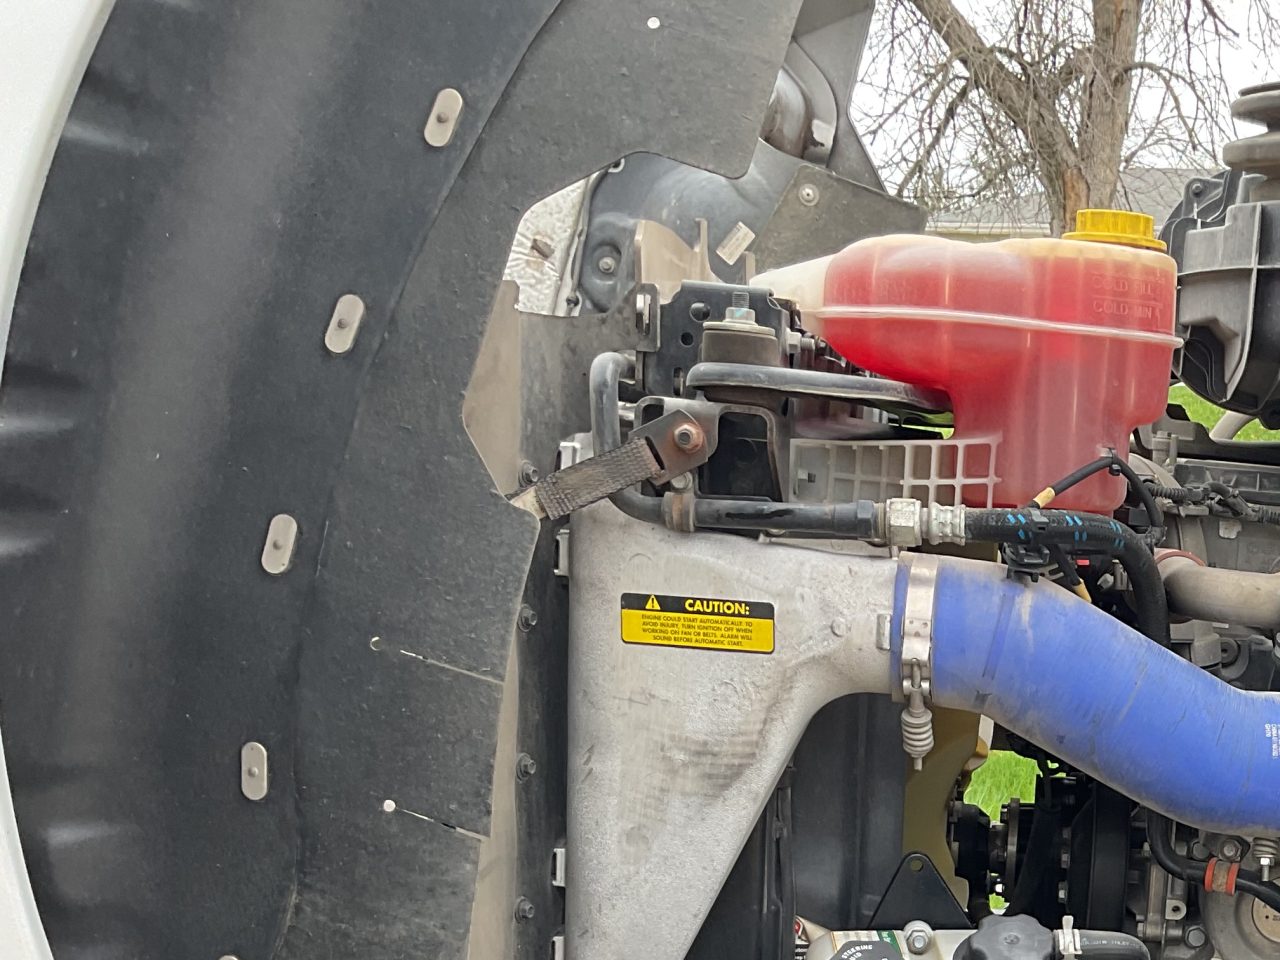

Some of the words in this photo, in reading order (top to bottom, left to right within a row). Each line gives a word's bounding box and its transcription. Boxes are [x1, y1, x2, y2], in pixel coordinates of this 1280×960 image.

[1093, 301, 1128, 315] COLD
[685, 599, 750, 615] CAUTION:
[694, 637, 726, 645] AUTOMATIC
[842, 945, 873, 959] STEERING
